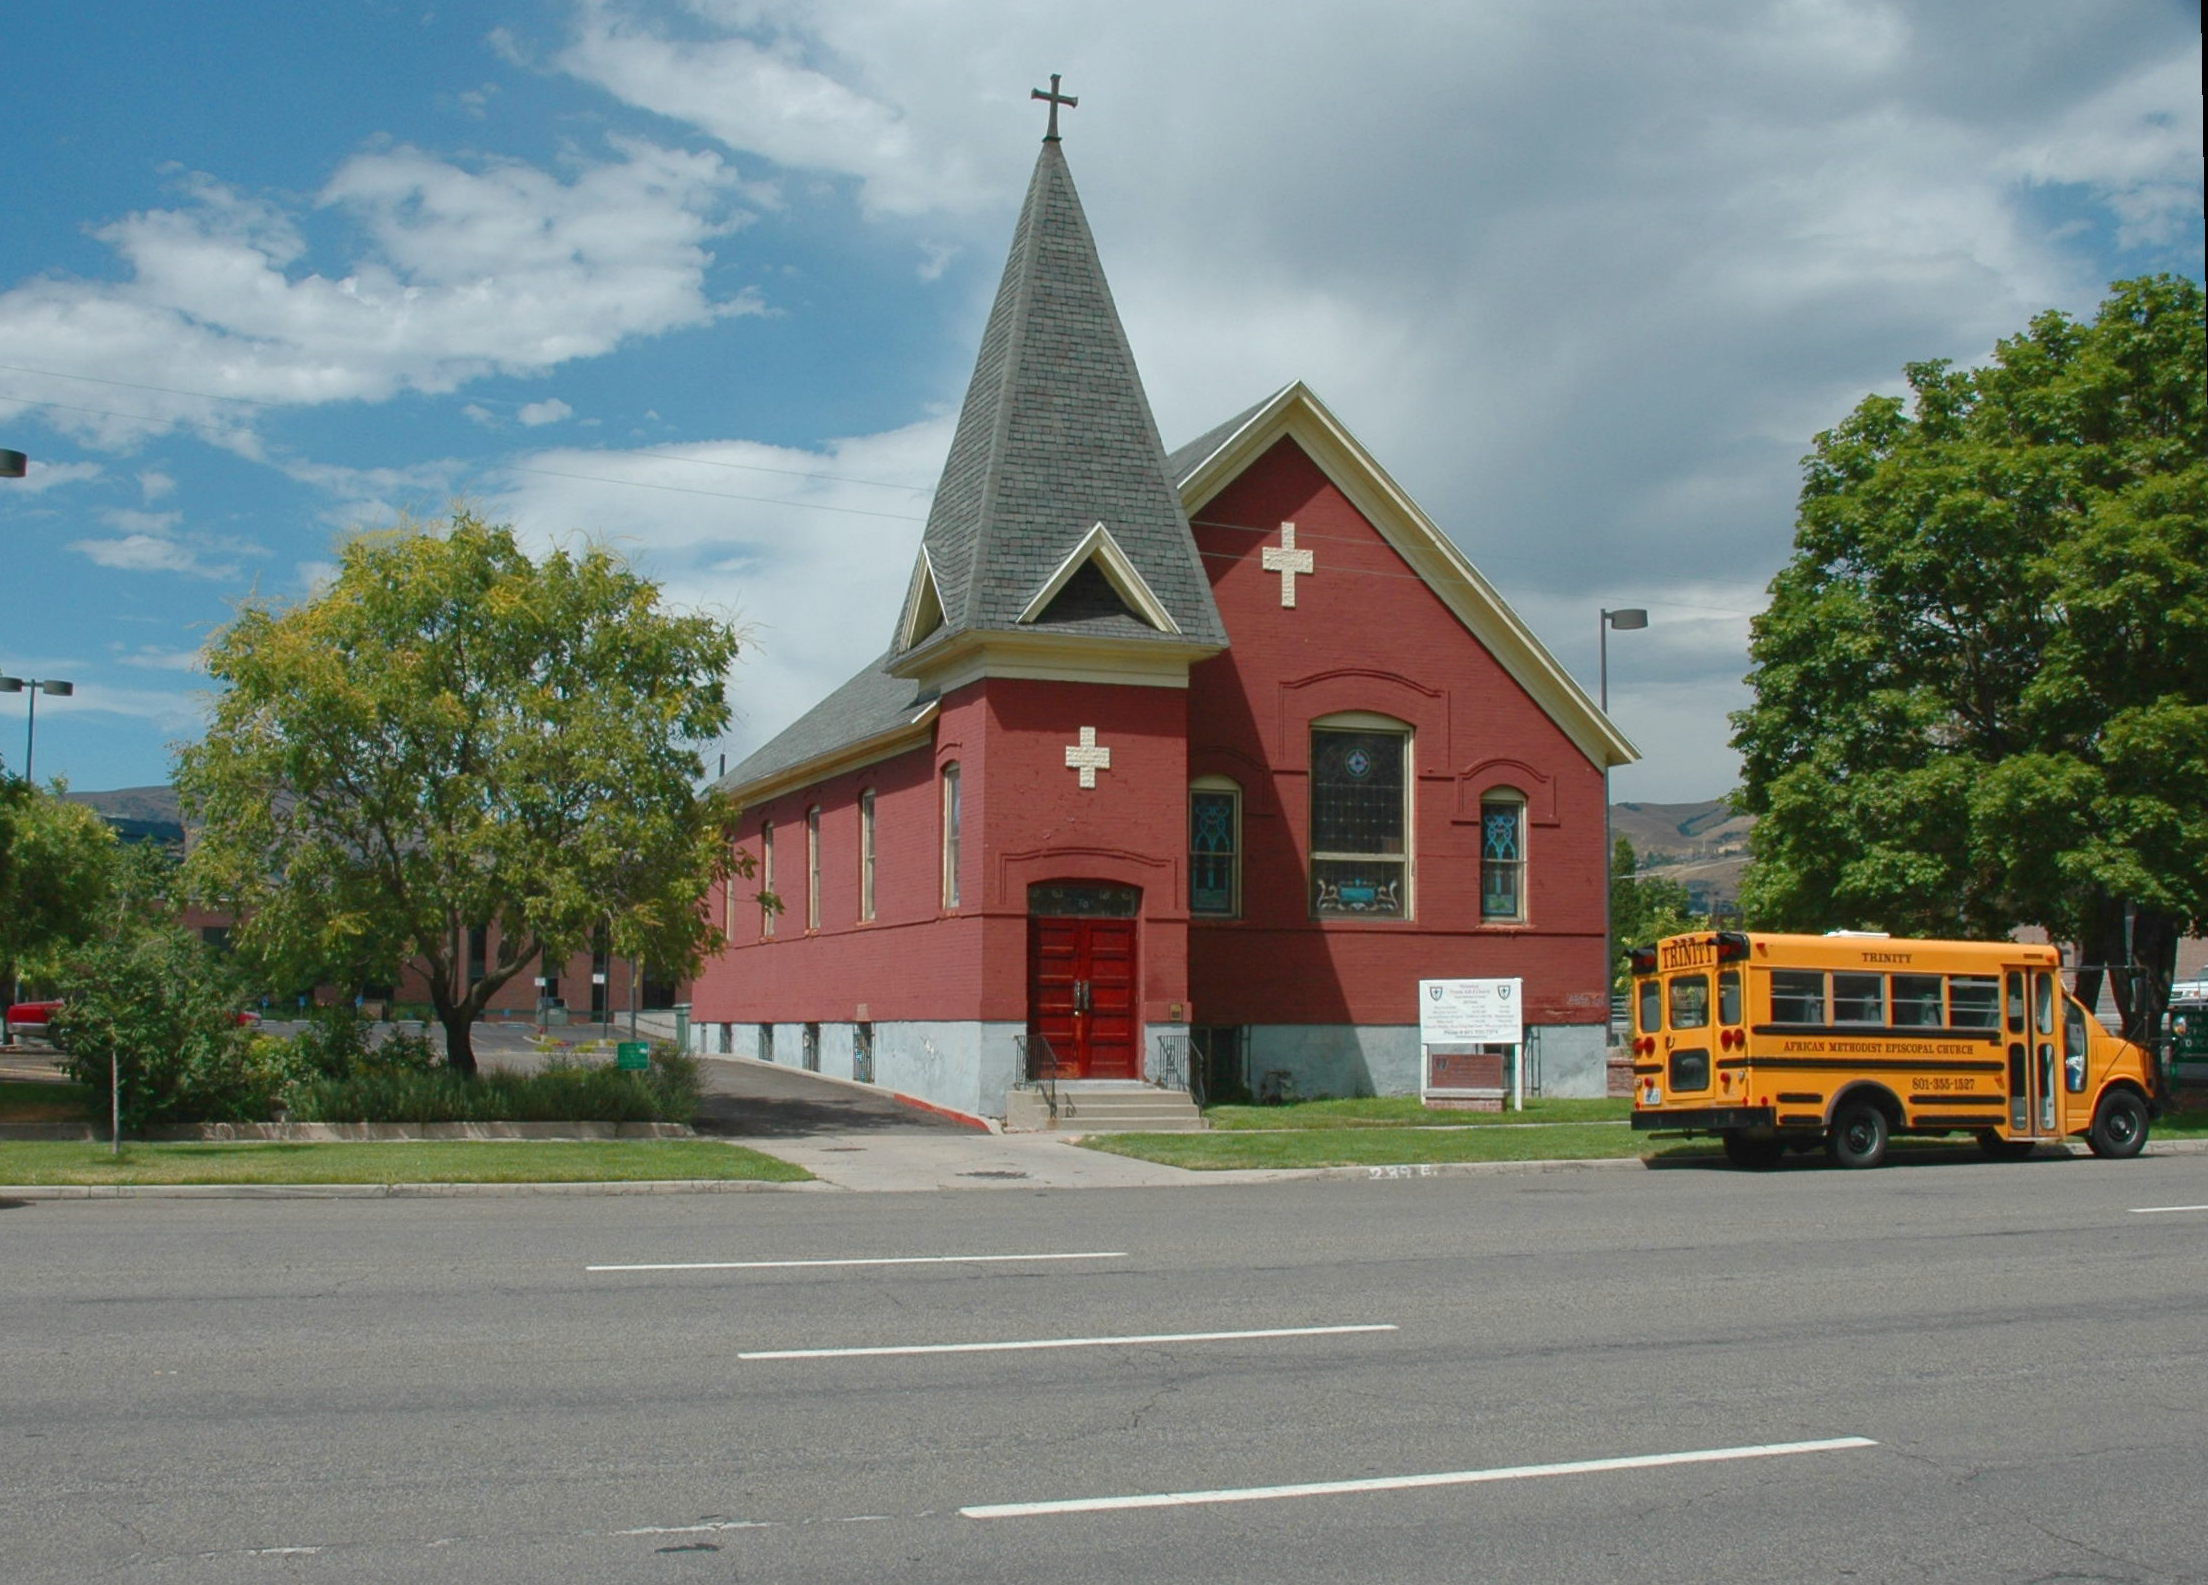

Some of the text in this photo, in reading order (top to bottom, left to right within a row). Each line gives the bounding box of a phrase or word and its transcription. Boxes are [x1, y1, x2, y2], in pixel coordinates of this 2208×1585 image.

[1661, 942, 1712, 969] TRINITY
[1861, 952, 1912, 964] TRINITY
[1784, 1041, 1974, 1056] AFRICAN METHODIST EPISCOPAL CHURCH
